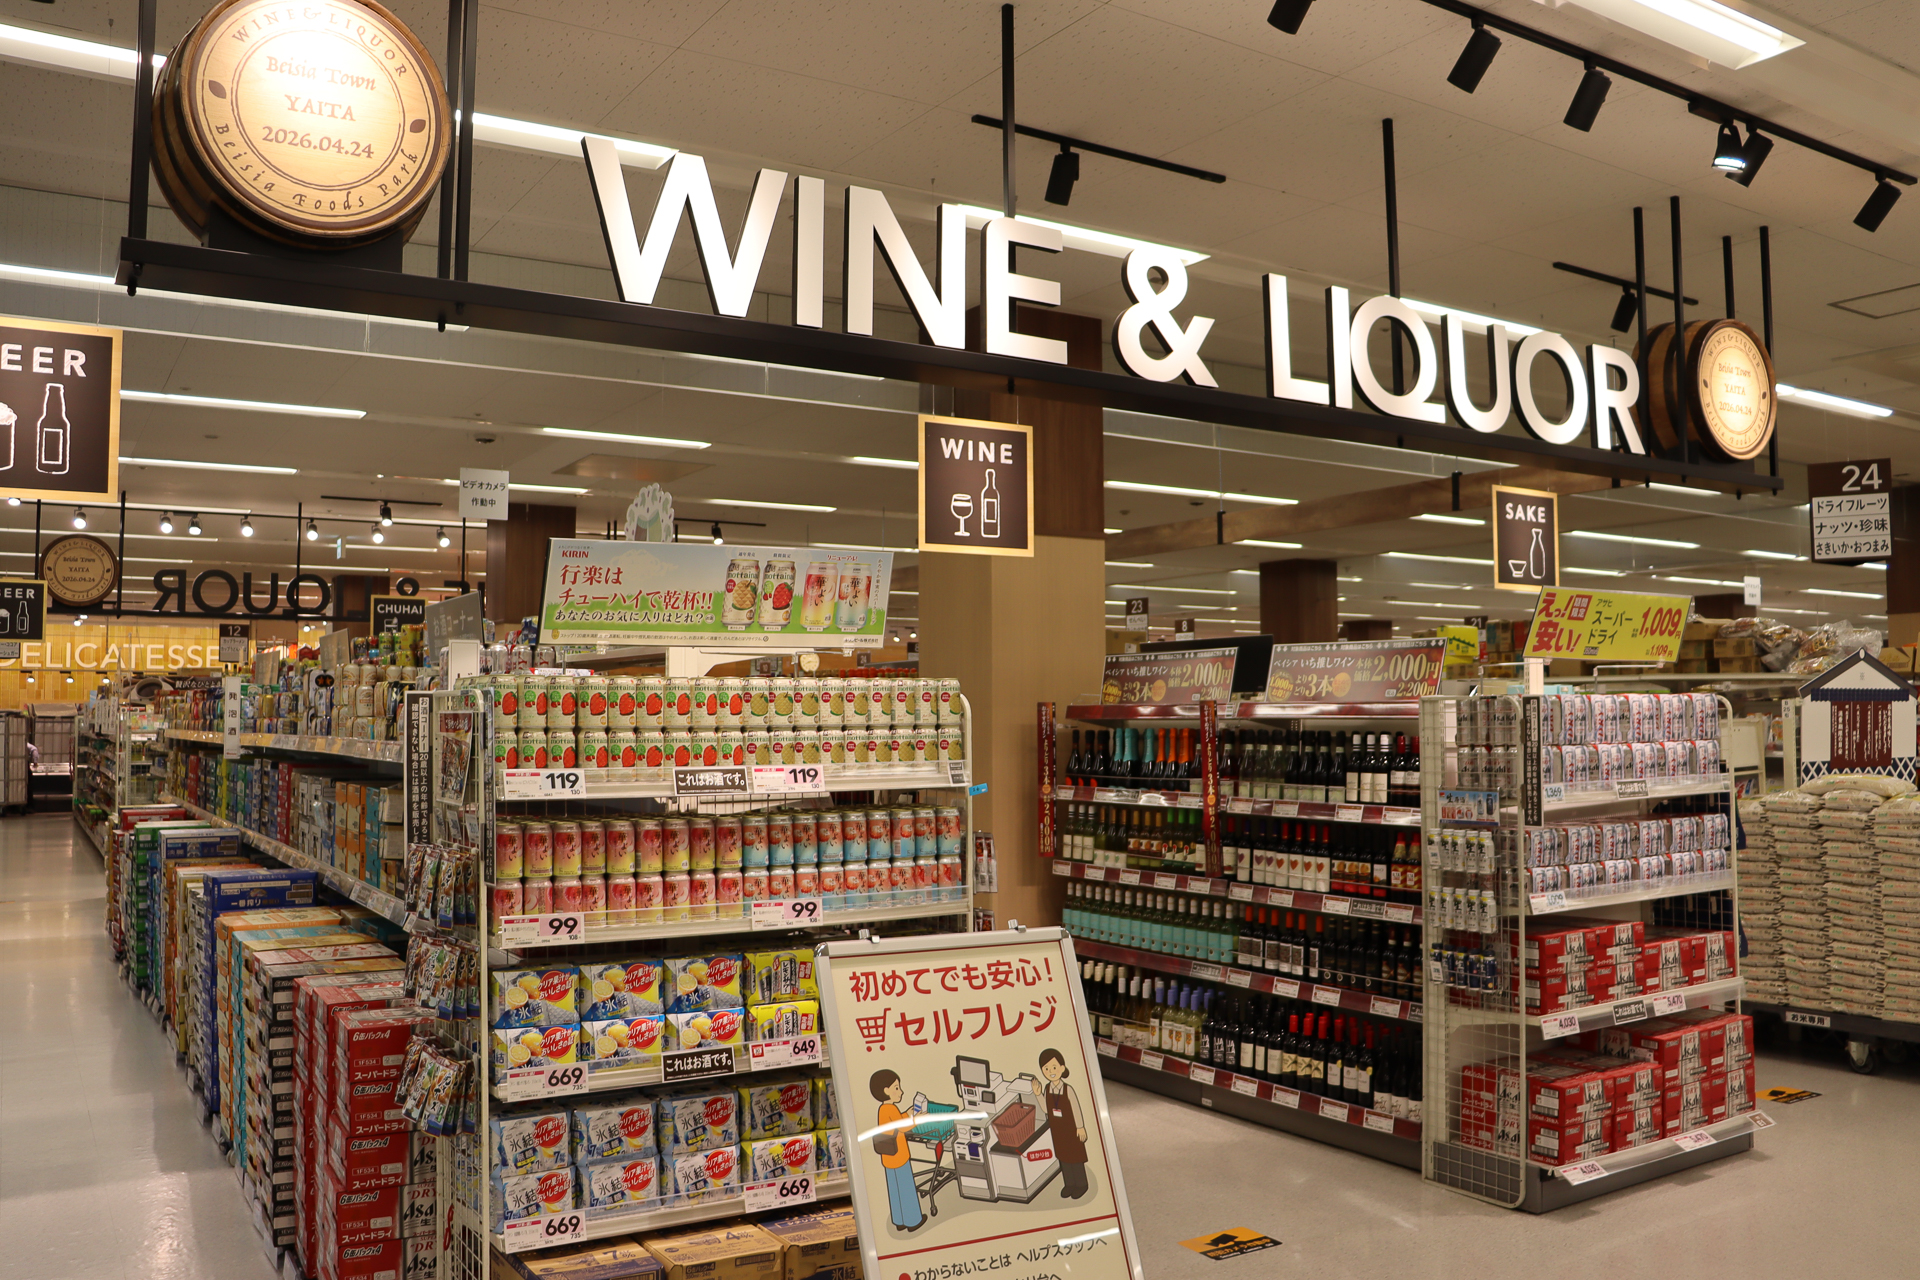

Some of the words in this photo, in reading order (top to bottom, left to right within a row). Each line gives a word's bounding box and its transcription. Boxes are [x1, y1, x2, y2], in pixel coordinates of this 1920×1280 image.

[232, 8, 296, 44] WINE
[303, 7, 322, 19] &
[330, 13, 408, 78] LIQUOR
[265, 56, 317, 80] Beisia
[325, 67, 377, 91] Town
[284, 94, 356, 122] YAITA
[262, 126, 374, 158] 2026.04.24
[215, 123, 276, 192] Beisia
[292, 190, 365, 212] Foods
[377, 148, 419, 196] Park
[581, 136, 1068, 366] WINE
[1112, 246, 1219, 388] &
[1262, 272, 1645, 455] LIQUOR
[1724, 383, 1746, 396] YAITA
[1718, 401, 1752, 416] 2026.04.24
[940, 436, 1014, 466] WINE
[462, 479, 507, 492] ビデオカメラ
[1841, 463, 1883, 492] 24
[471, 497, 497, 508] 作動中
[1817, 497, 1887, 514] ドライフルーツ
[1505, 501, 1547, 525] SAKE
[1815, 517, 1888, 535] ナッツ・珍味
[561, 550, 589, 559] KIRIN
[1816, 539, 1889, 556] さきいか・おつまみ
[559, 564, 624, 586] 行楽は
[558, 587, 714, 611] チューハイで乾杯!!
[1131, 599, 1143, 614] 23
[1537, 591, 1575, 619] えっ!
[1574, 597, 1589, 607] 期間
[1596, 598, 1613, 608] アサヒ
[376, 603, 423, 615] CHUHAI
[554, 608, 705, 624] あなたのお気に入りはどれ?
[1571, 607, 1586, 618] 限定
[1181, 620, 1188, 632] 8
[1591, 610, 1634, 627] スーパー
[1639, 606, 1682, 640] 1,009円
[227, 625, 242, 637] 12
[1532, 619, 1583, 653] 安い!
[1587, 628, 1618, 645] ドライ
[1105, 667, 1125, 677] ベイシア
[1126, 665, 1169, 677] いち推しワイン
[1273, 658, 1299, 668] ベイシア
[1300, 656, 1355, 669] いち推しワイン
[1355, 657, 1373, 669] 本体
[1371, 653, 1440, 682] 2,000円
[1181, 661, 1232, 688] 2,000円
[1295, 674, 1308, 684] より
[1353, 669, 1371, 682] 価格
[1131, 680, 1153, 702] 3本
[1200, 686, 1229, 701] 2,200円
[1293, 685, 1306, 696] どり
[1305, 673, 1334, 697] 3本
[1396, 681, 1436, 697] 2,200円
[419, 698, 429, 752] お酒コーナー
[1530, 699, 1539, 741] お酒コーナー
[545, 772, 580, 790] 119
[677, 772, 746, 786] これはお酒です。
[788, 767, 819, 784] 119
[1544, 787, 1562, 798] 1,369
[791, 901, 818, 918] 99
[548, 916, 579, 935] 99
[568, 933, 578, 941] 108
[624, 965, 655, 983] クリア果汁が
[706, 958, 736, 976] クリア果汁が
[538, 972, 571, 990] クリア果汁が
[624, 975, 657, 993] おいしさの証
[707, 967, 738, 986] おいしさの証
[849, 957, 1053, 1003] 初めてでも安心!
[538, 982, 573, 1000] おいしさの証
[1667, 994, 1683, 1007] 5,470
[894, 995, 1058, 1046] セルフレジ
[1558, 1016, 1576, 1029] 4,030
[1791, 1012, 1826, 1027] お米専用
[540, 1028, 573, 1047] クリア果汁が
[627, 1020, 658, 1039] クリア果汁が
[541, 1037, 575, 1057] おいしさの証
[627, 1031, 660, 1049] おいしさの証
[792, 1039, 816, 1055] 649
[666, 1051, 732, 1072] これはお酒です。
[547, 1066, 583, 1088] 669
[572, 1083, 584, 1091] 735
[355, 1122, 406, 1135] スーパードライ
[595, 1123, 620, 1143] 氷結
[510, 1132, 534, 1152] 氷結
[1029, 1149, 1051, 1159] はかり台
[1580, 1161, 1601, 1175] 4,030
[352, 1176, 403, 1190] スーパードライ
[779, 1177, 810, 1198] 669
[345, 1221, 364, 1229] 1F534
[545, 1215, 581, 1236] 669
[341, 1230, 393, 1244] スーパードライ
[570, 1232, 581, 1240] 735
[913, 1252, 1012, 1280] わからないことは
[1016, 1237, 1108, 1263] ヘルプスタッフへ
